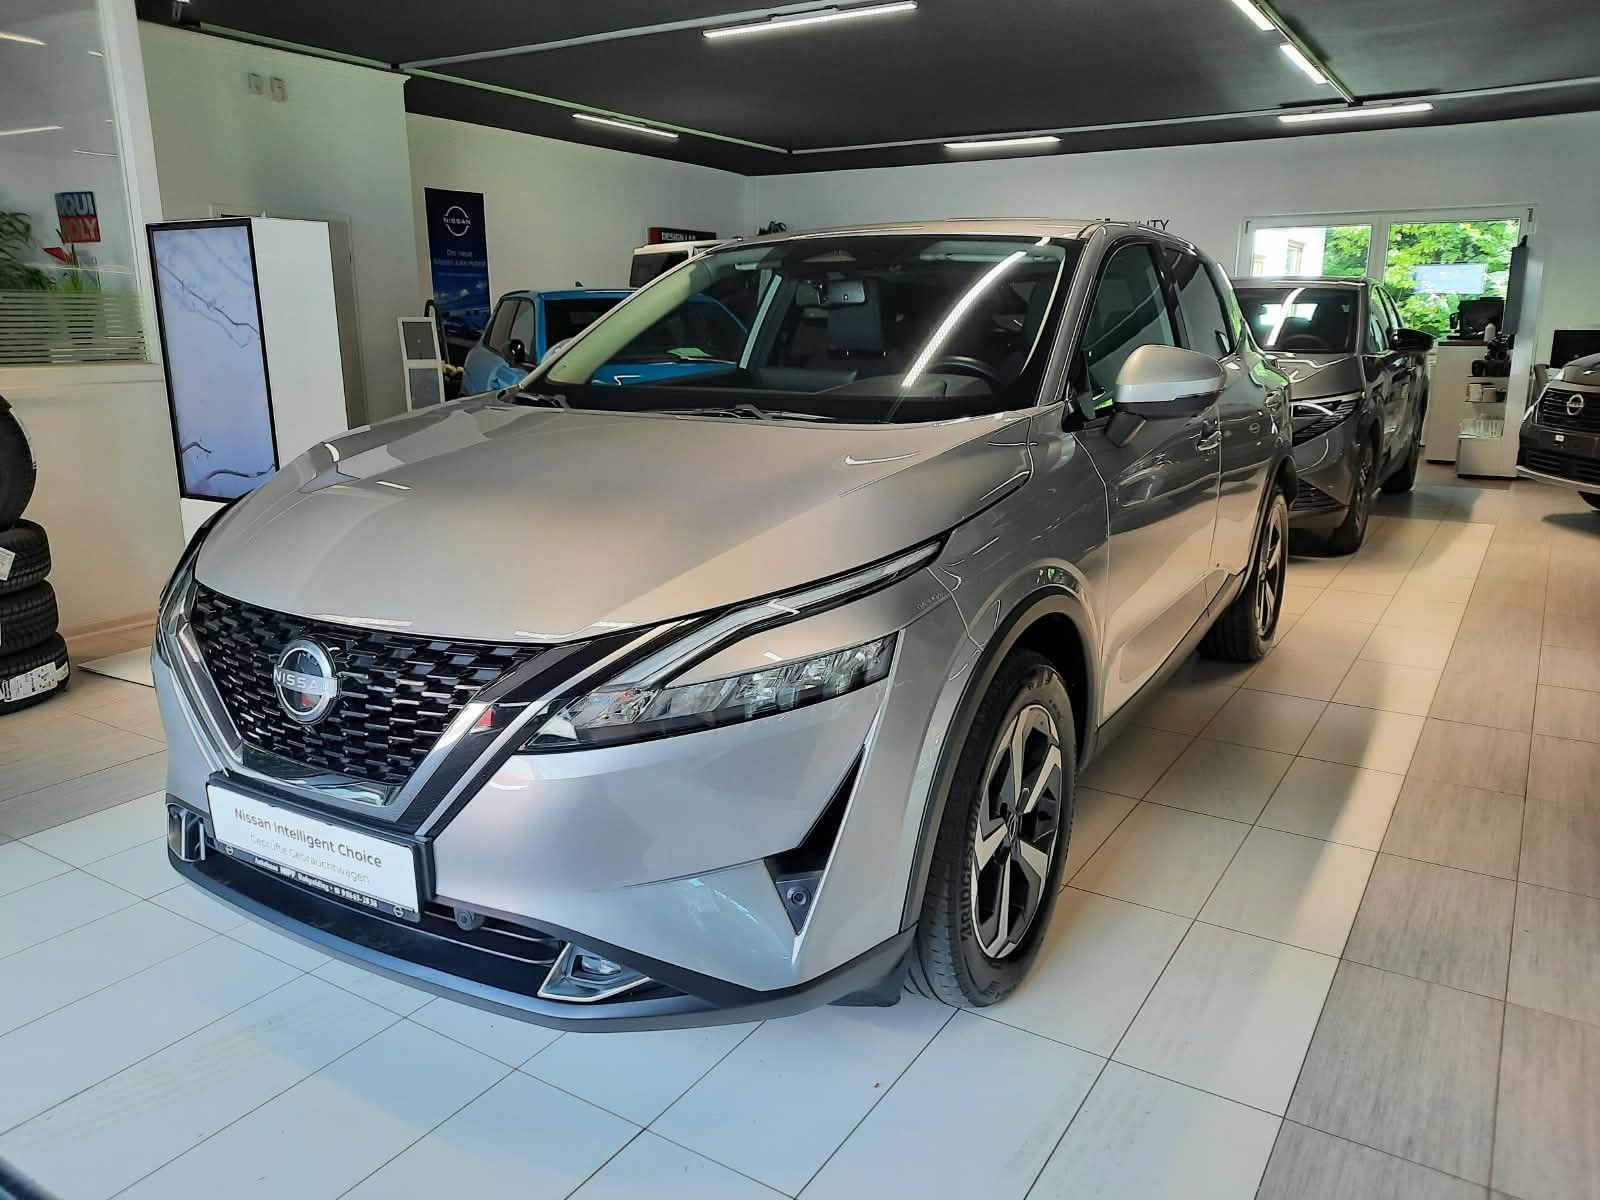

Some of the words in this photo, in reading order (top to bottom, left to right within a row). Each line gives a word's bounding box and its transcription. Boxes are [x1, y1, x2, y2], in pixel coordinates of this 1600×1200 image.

[443, 217, 471, 225] NISSAN
[273, 669, 329, 690] NISSA
[234, 808, 272, 831] Nissan
[274, 822, 335, 853] Intelligent
[338, 844, 382, 868] Choice
